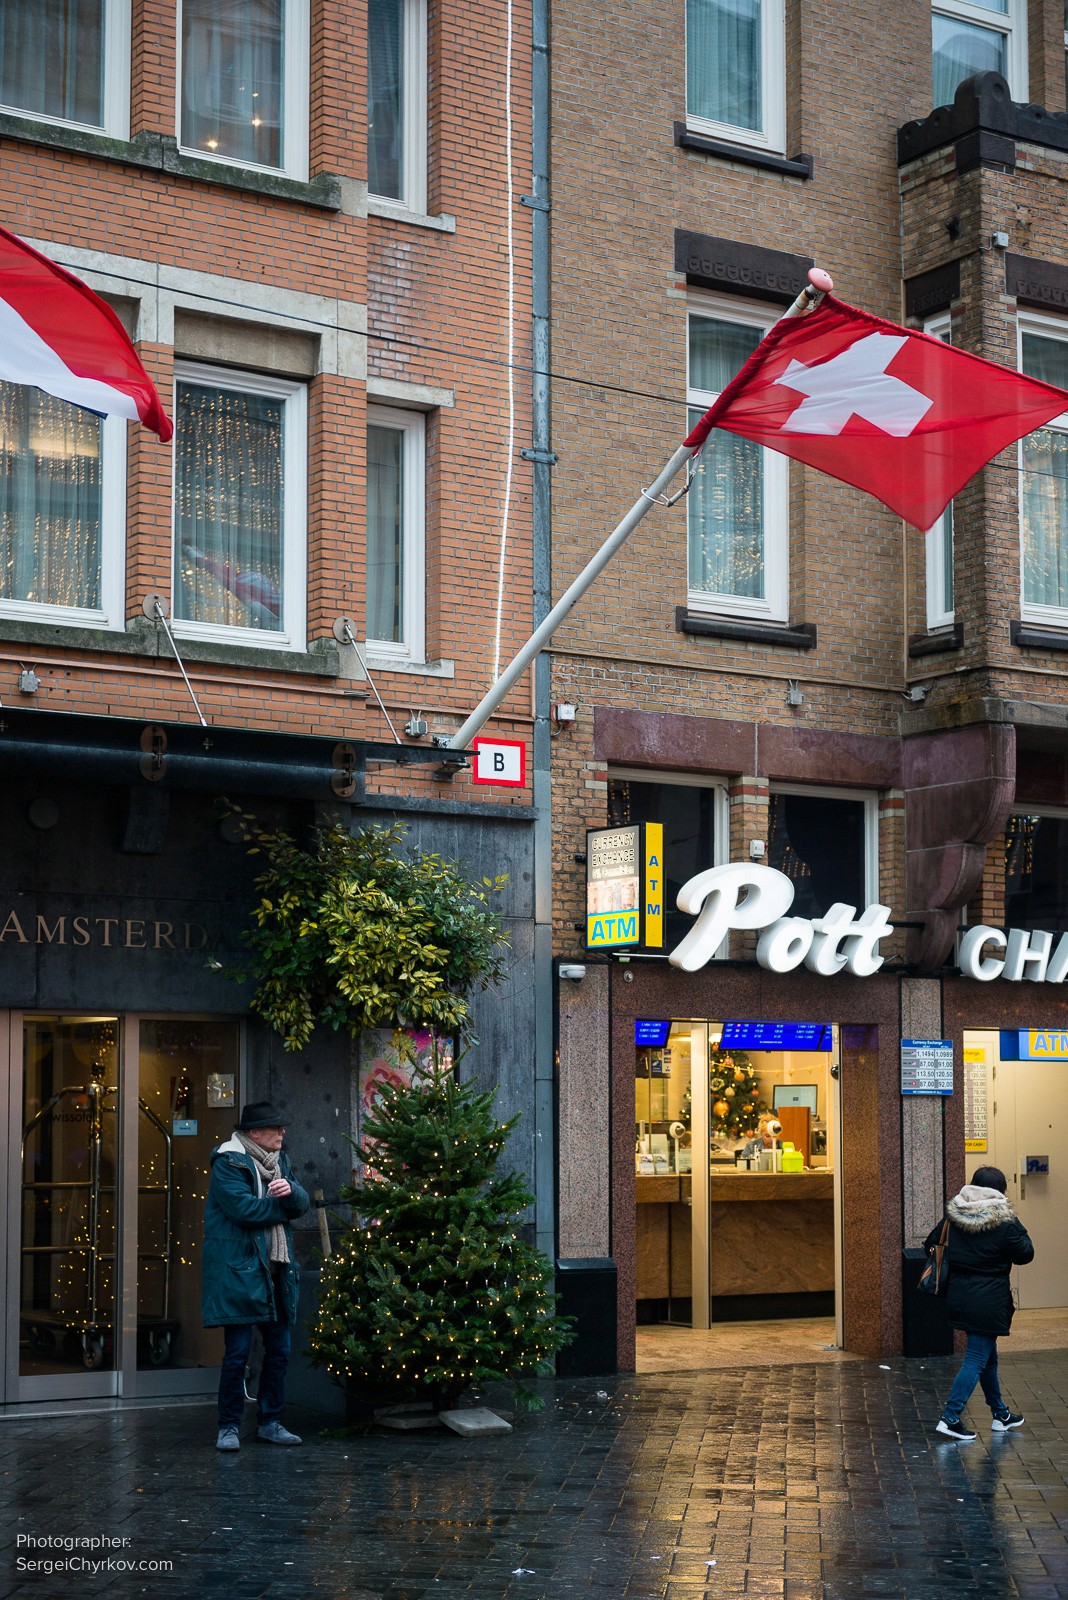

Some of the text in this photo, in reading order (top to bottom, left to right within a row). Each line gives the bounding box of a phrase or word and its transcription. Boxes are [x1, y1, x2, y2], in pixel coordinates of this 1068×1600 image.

[494, 752, 505, 772] B
[592, 832, 635, 851] CURRENCY
[592, 849, 635, 867] EXCHANGE
[648, 855, 661, 915] ATM
[592, 916, 636, 941] ATM
[669, 862, 894, 977] Pott
